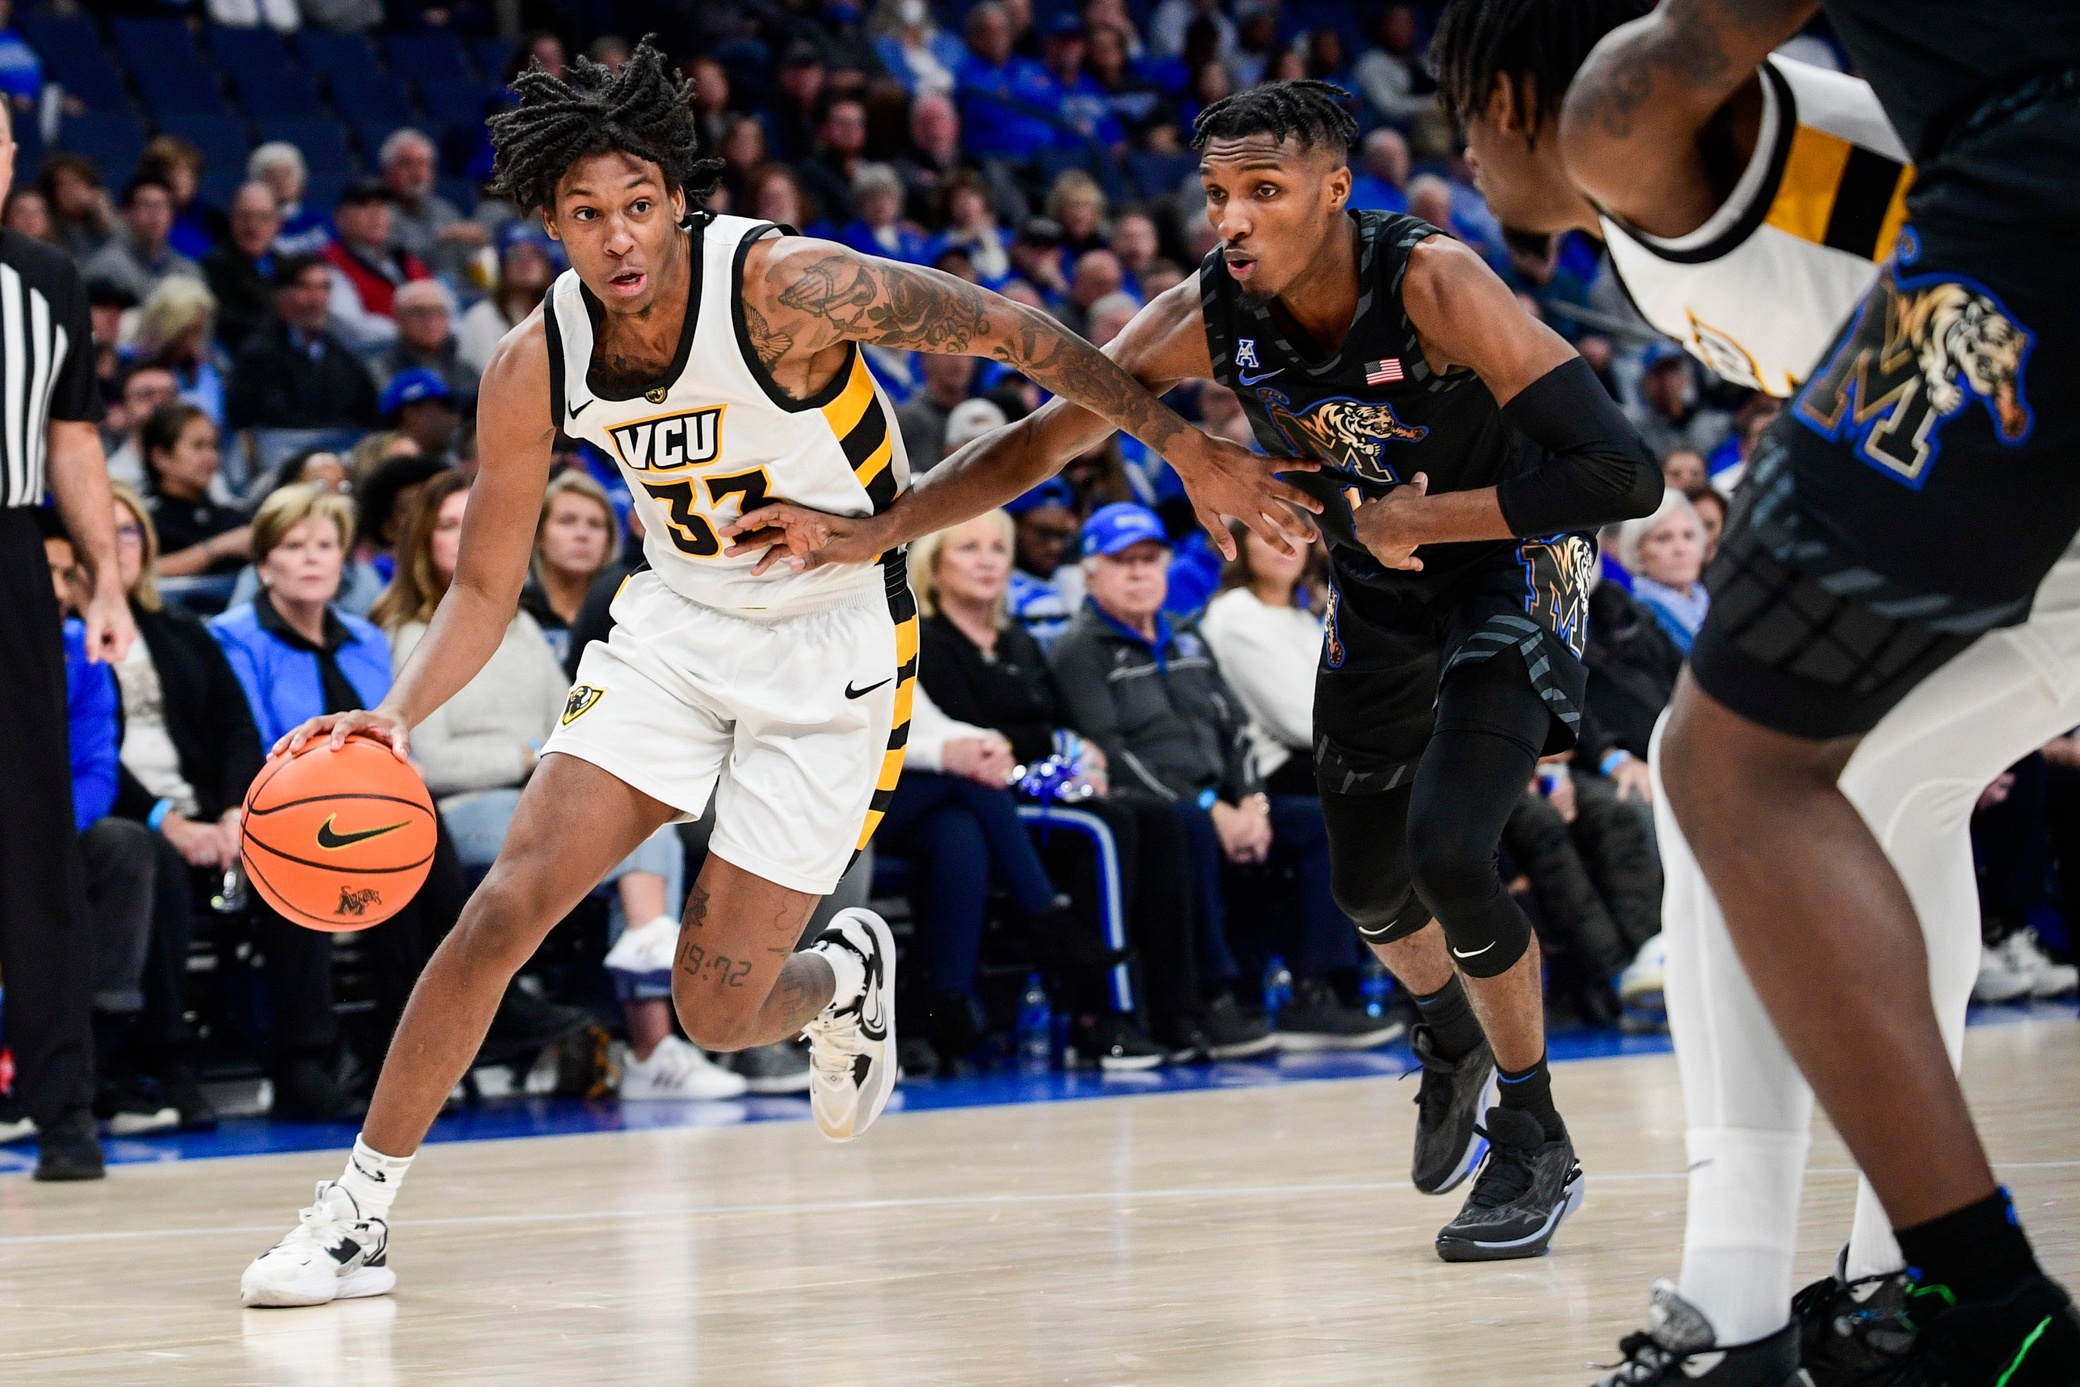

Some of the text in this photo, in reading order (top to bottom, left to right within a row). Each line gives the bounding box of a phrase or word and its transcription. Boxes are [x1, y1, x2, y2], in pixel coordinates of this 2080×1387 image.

[1235, 339, 1259, 368] A
[608, 408, 722, 470] VCU
[680, 941, 752, 987] 19:72
